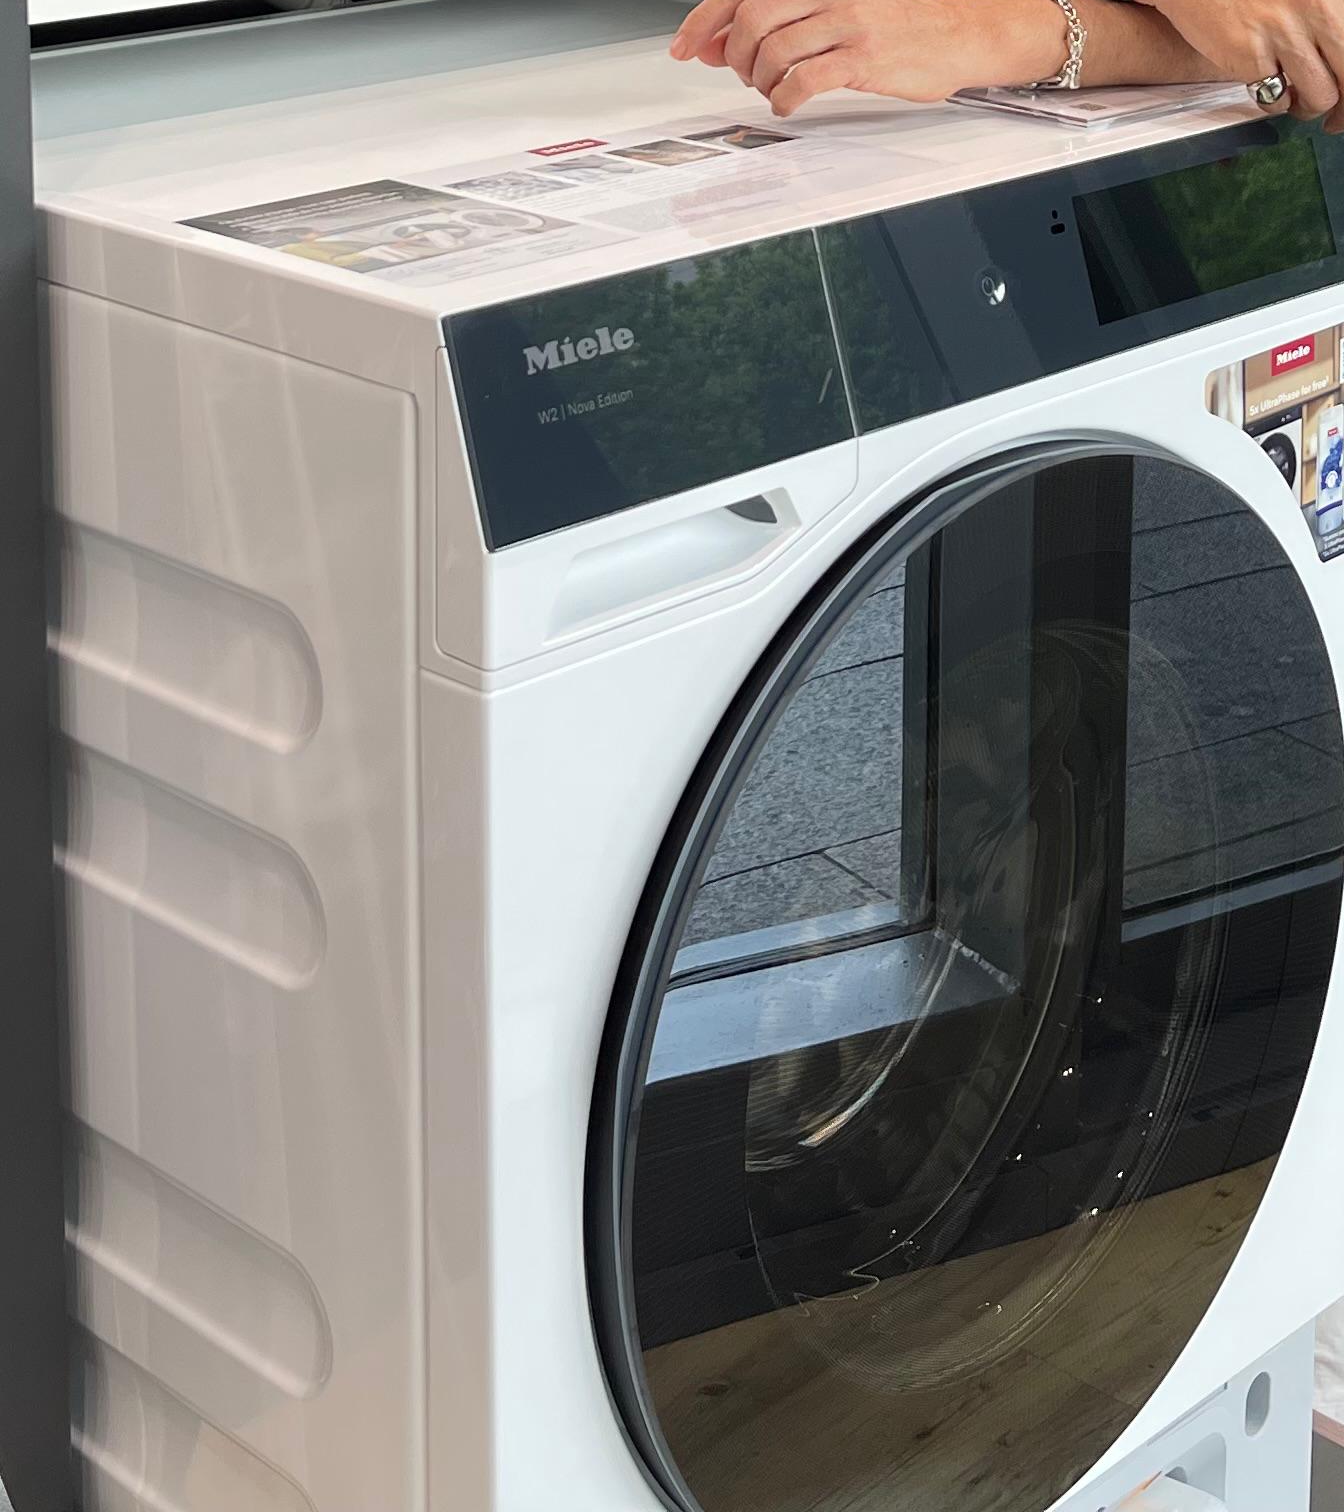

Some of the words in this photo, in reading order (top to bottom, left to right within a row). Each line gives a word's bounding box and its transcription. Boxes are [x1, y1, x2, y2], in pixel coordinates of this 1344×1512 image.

[522, 326, 635, 376] Miele
[1275, 345, 1311, 366] Miele
[537, 407, 559, 425] W2
[567, 399, 596, 416] Nova
[596, 389, 634, 409] Edition
[1249, 403, 1260, 417] 5x
[1259, 389, 1300, 410] UltraPhase
[1301, 384, 1312, 395] for
